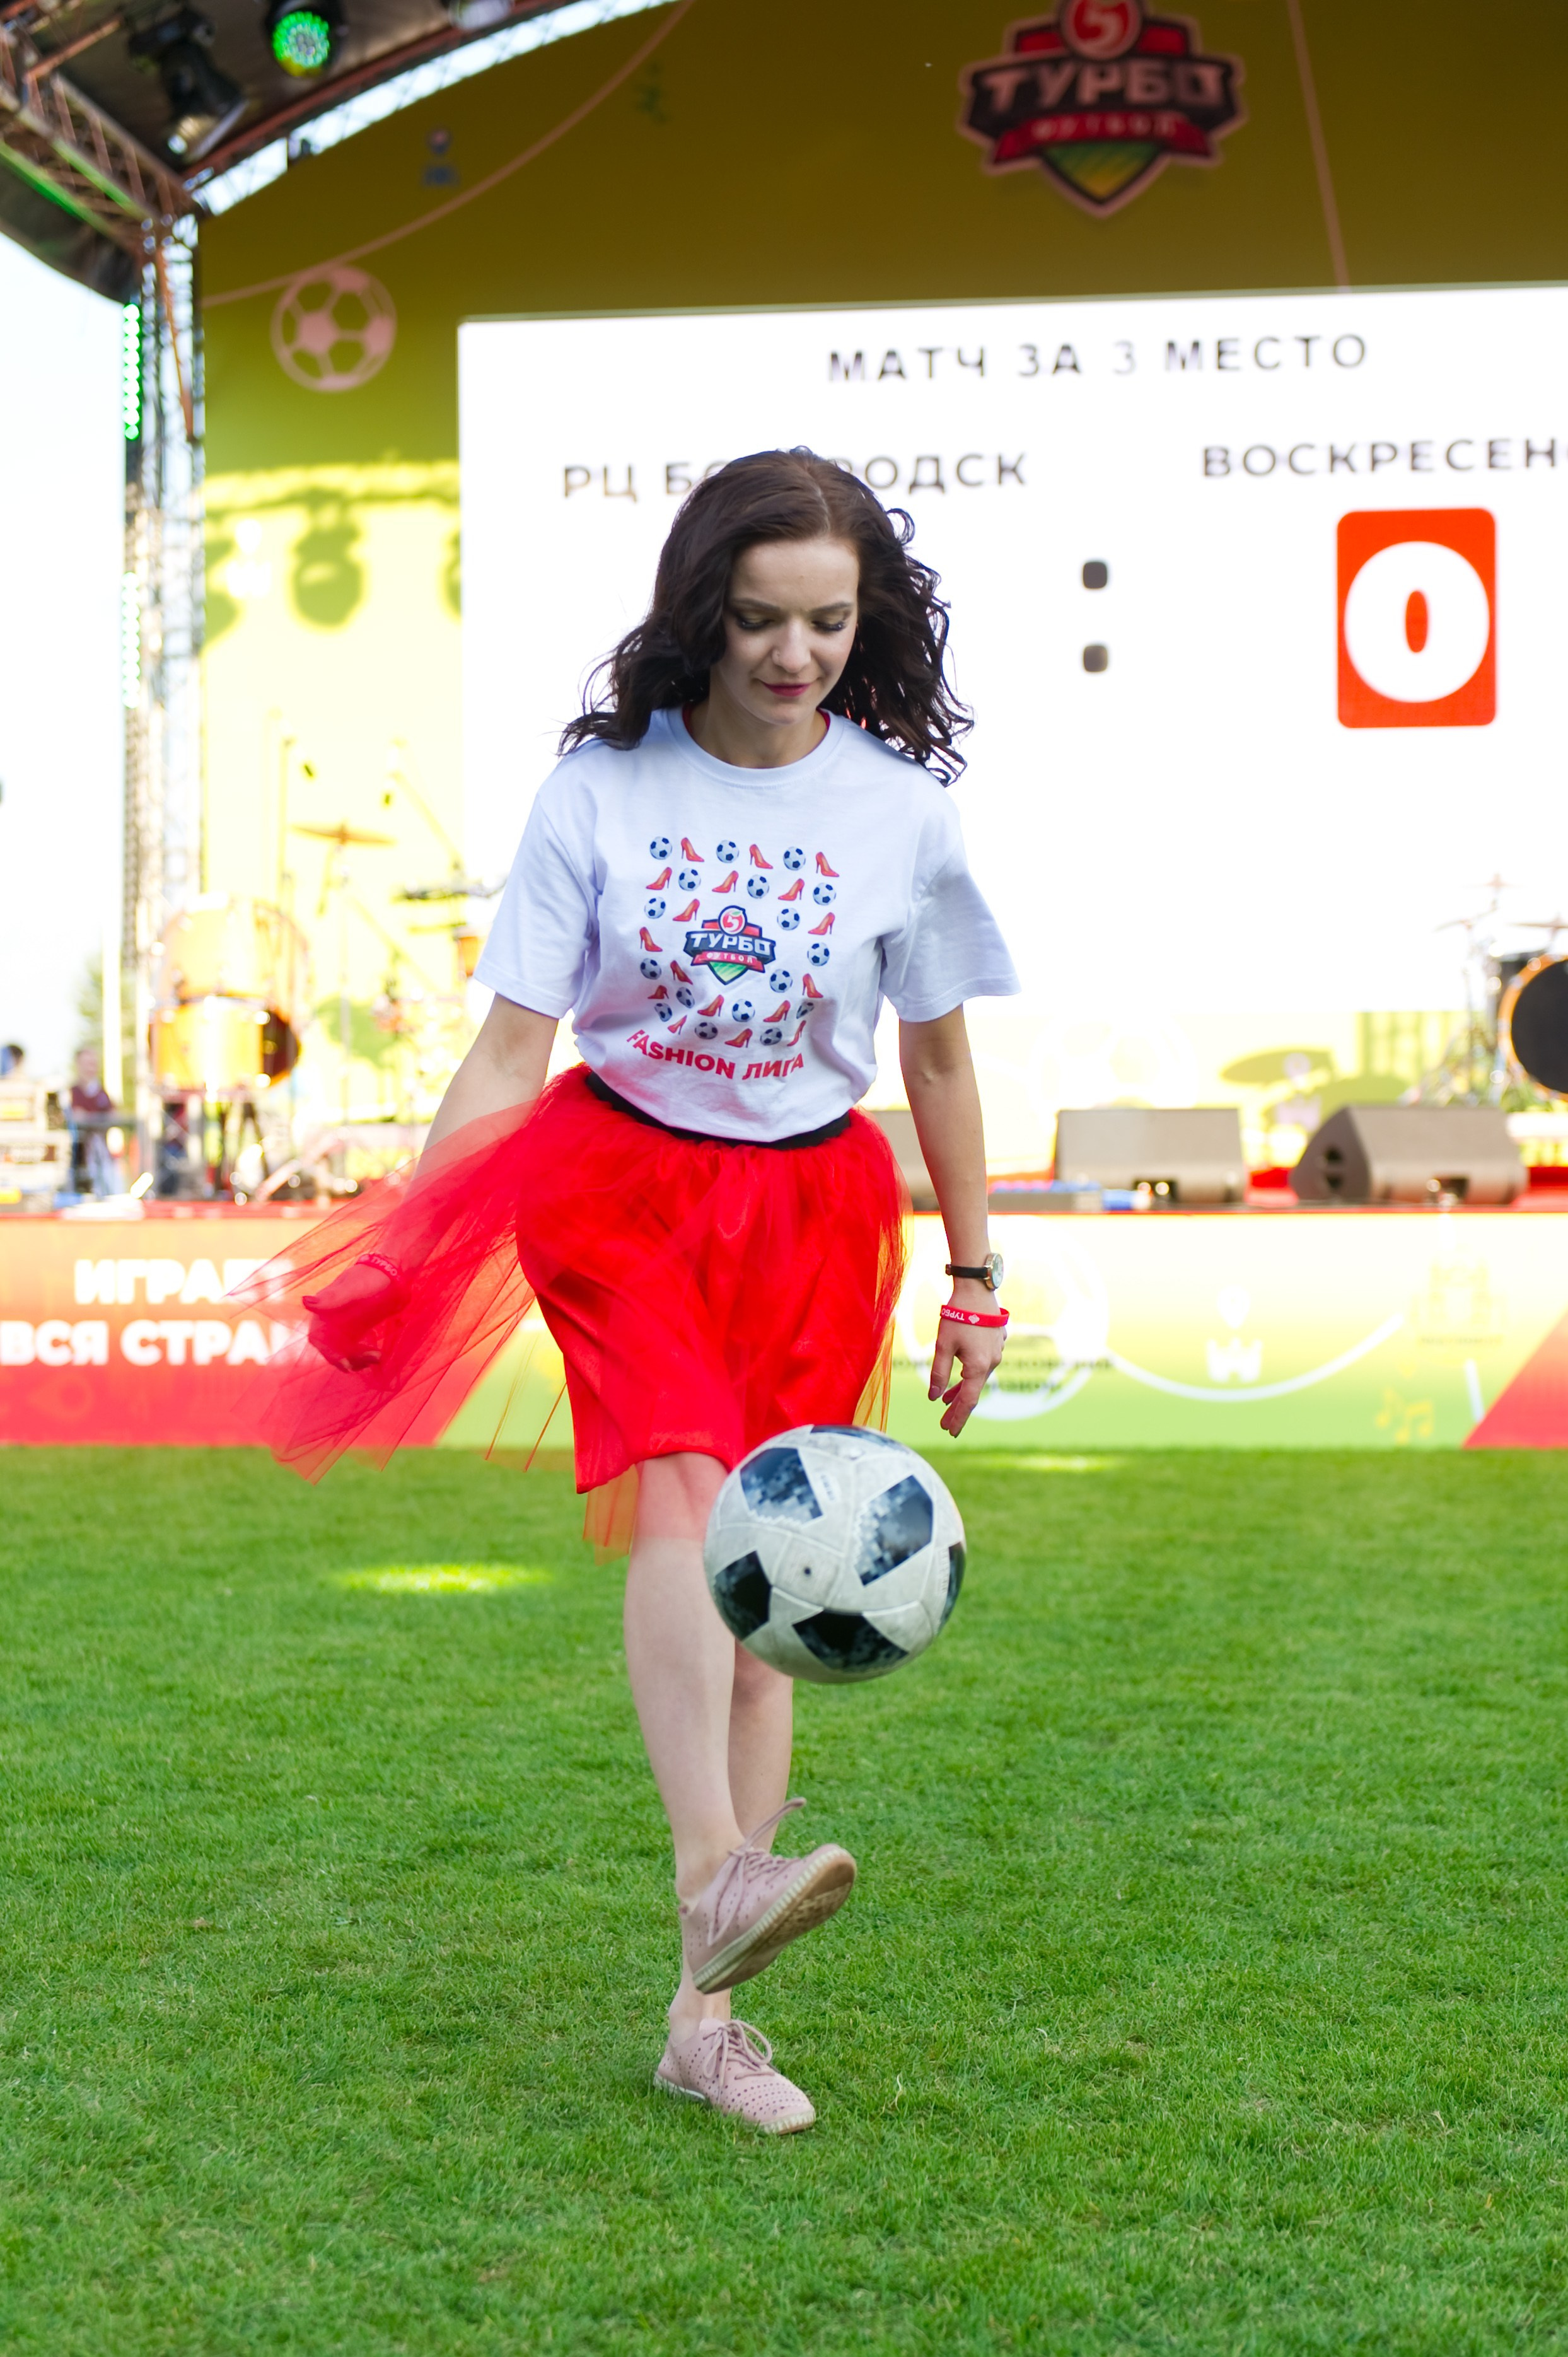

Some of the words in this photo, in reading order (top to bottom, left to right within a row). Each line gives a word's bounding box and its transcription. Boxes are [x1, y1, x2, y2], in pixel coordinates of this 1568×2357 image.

[982, 59, 1228, 113] ТУРБО
[828, 346, 986, 381] МАТЧ
[1019, 342, 1082, 377] ЗА
[1114, 340, 1137, 375] 3
[1165, 334, 1367, 371] МЕСТО
[563, 464, 639, 504] РЦ
[664, 453, 1026, 496] БОДСК
[1202, 438, 1568, 478] ВОСКРЕСЕН
[1344, 541, 1490, 704] 0
[690, 933, 771, 956] ТУРБО
[706, 952, 753, 963] ФУТБОЛ
[626, 1029, 736, 1080] FASHION
[741, 1053, 804, 1080] ЛИГА
[941, 1308, 965, 1321] ТУРБО
[0, 1319, 110, 1366] ВСЯ
[120, 1319, 313, 1366] СТРАН
